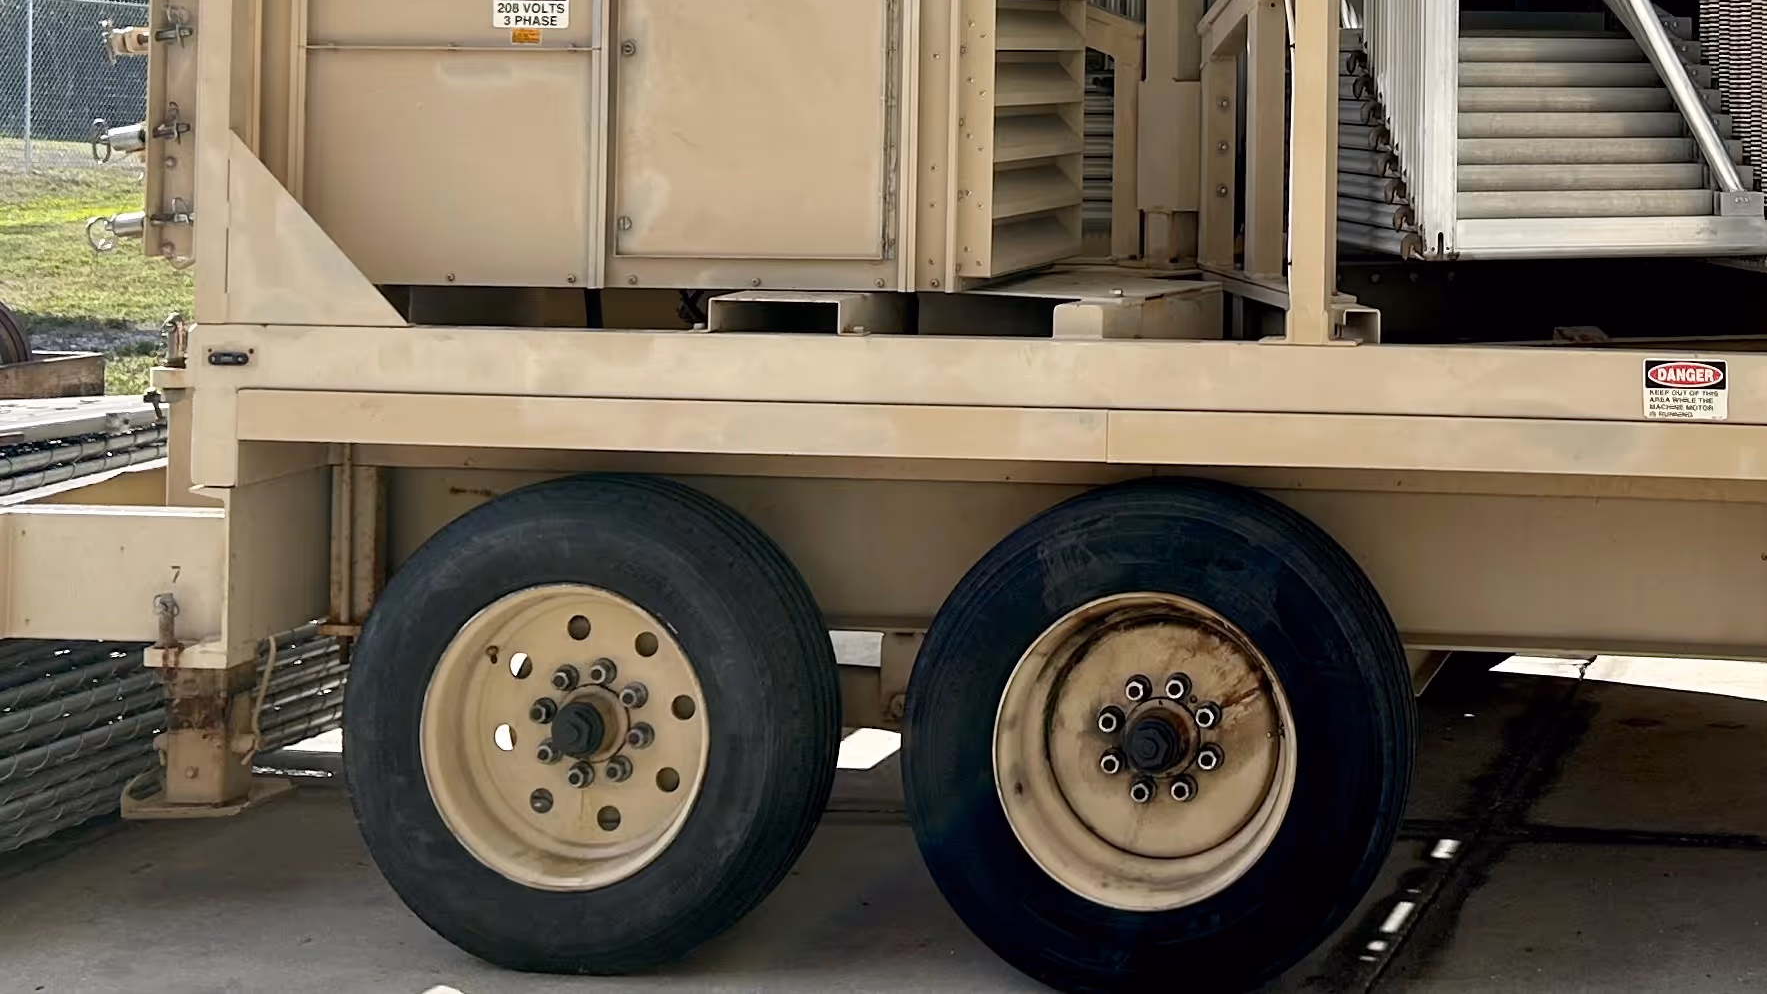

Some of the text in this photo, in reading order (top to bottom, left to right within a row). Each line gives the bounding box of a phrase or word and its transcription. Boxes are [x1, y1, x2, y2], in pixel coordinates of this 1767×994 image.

[497, 2, 565, 13] 208 VOLTS
[503, 15, 558, 26] 3 PHASE
[1657, 368, 1714, 382] DANGER
[171, 565, 181, 584] 7
